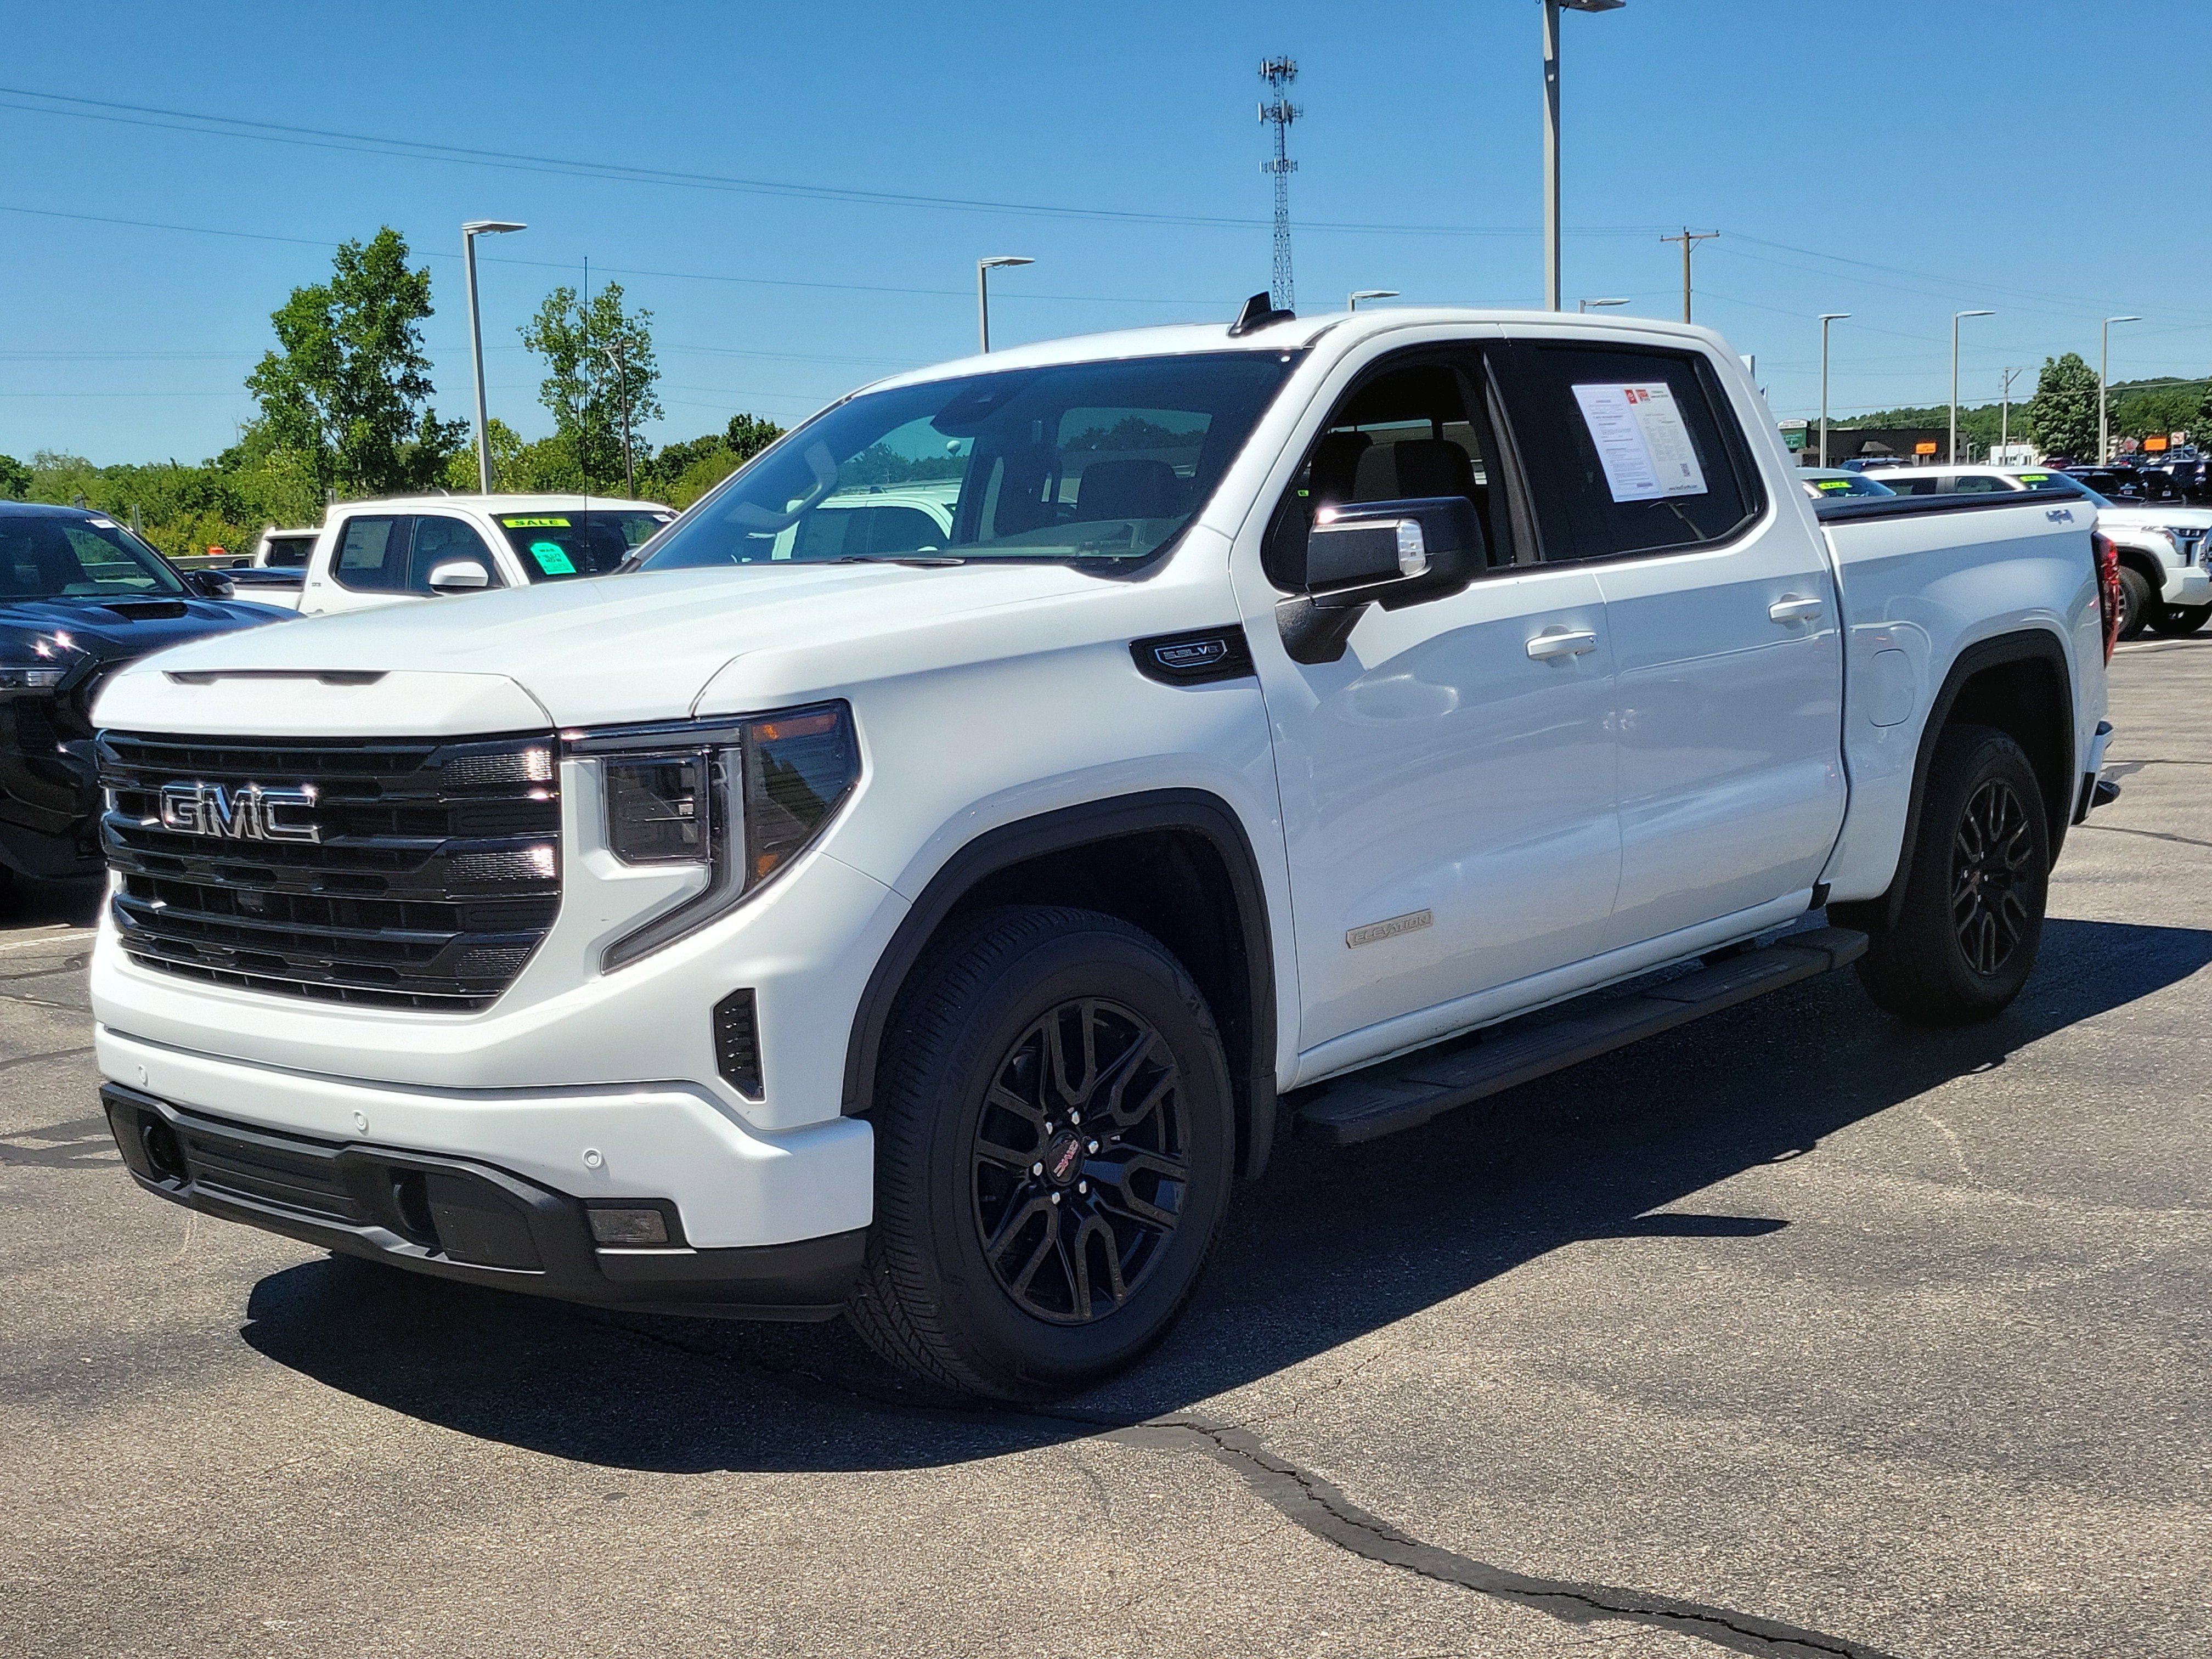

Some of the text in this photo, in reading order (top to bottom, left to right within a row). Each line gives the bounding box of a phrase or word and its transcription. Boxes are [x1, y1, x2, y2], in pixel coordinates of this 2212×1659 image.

[160, 781, 324, 845] GMC
[1354, 911, 1432, 943] ELEVATION
[1053, 1139, 1079, 1177] GMC
